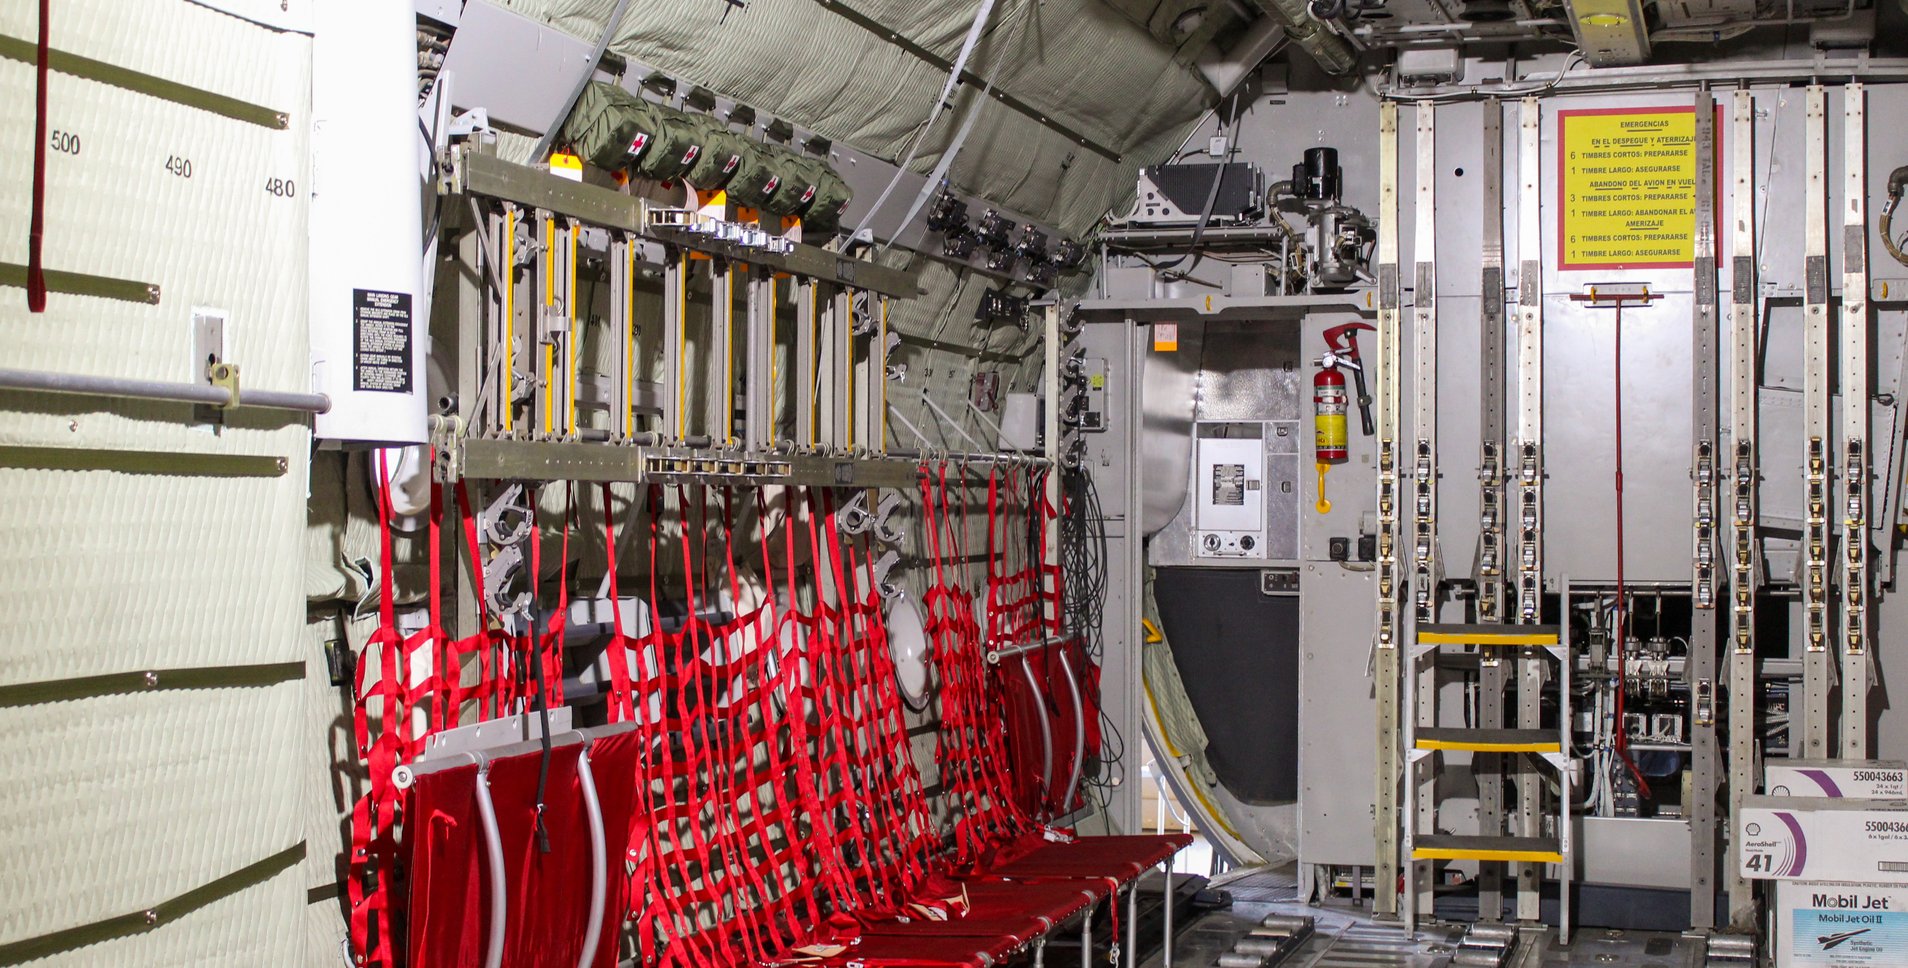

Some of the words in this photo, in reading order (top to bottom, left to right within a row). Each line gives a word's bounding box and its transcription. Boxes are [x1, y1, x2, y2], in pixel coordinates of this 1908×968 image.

[1620, 120, 1669, 128] EMERGENCIAS
[50, 130, 81, 155] 500
[165, 155, 192, 179] 490
[265, 177, 295, 197] 480
[1571, 250, 1576, 258] 1
[1853, 771, 1903, 782] 550043663
[1746, 854, 1772, 872] 41
[1813, 894, 1857, 908] Mobil
[1862, 896, 1888, 909] Jet
[1819, 914, 1844, 922] Mobil
